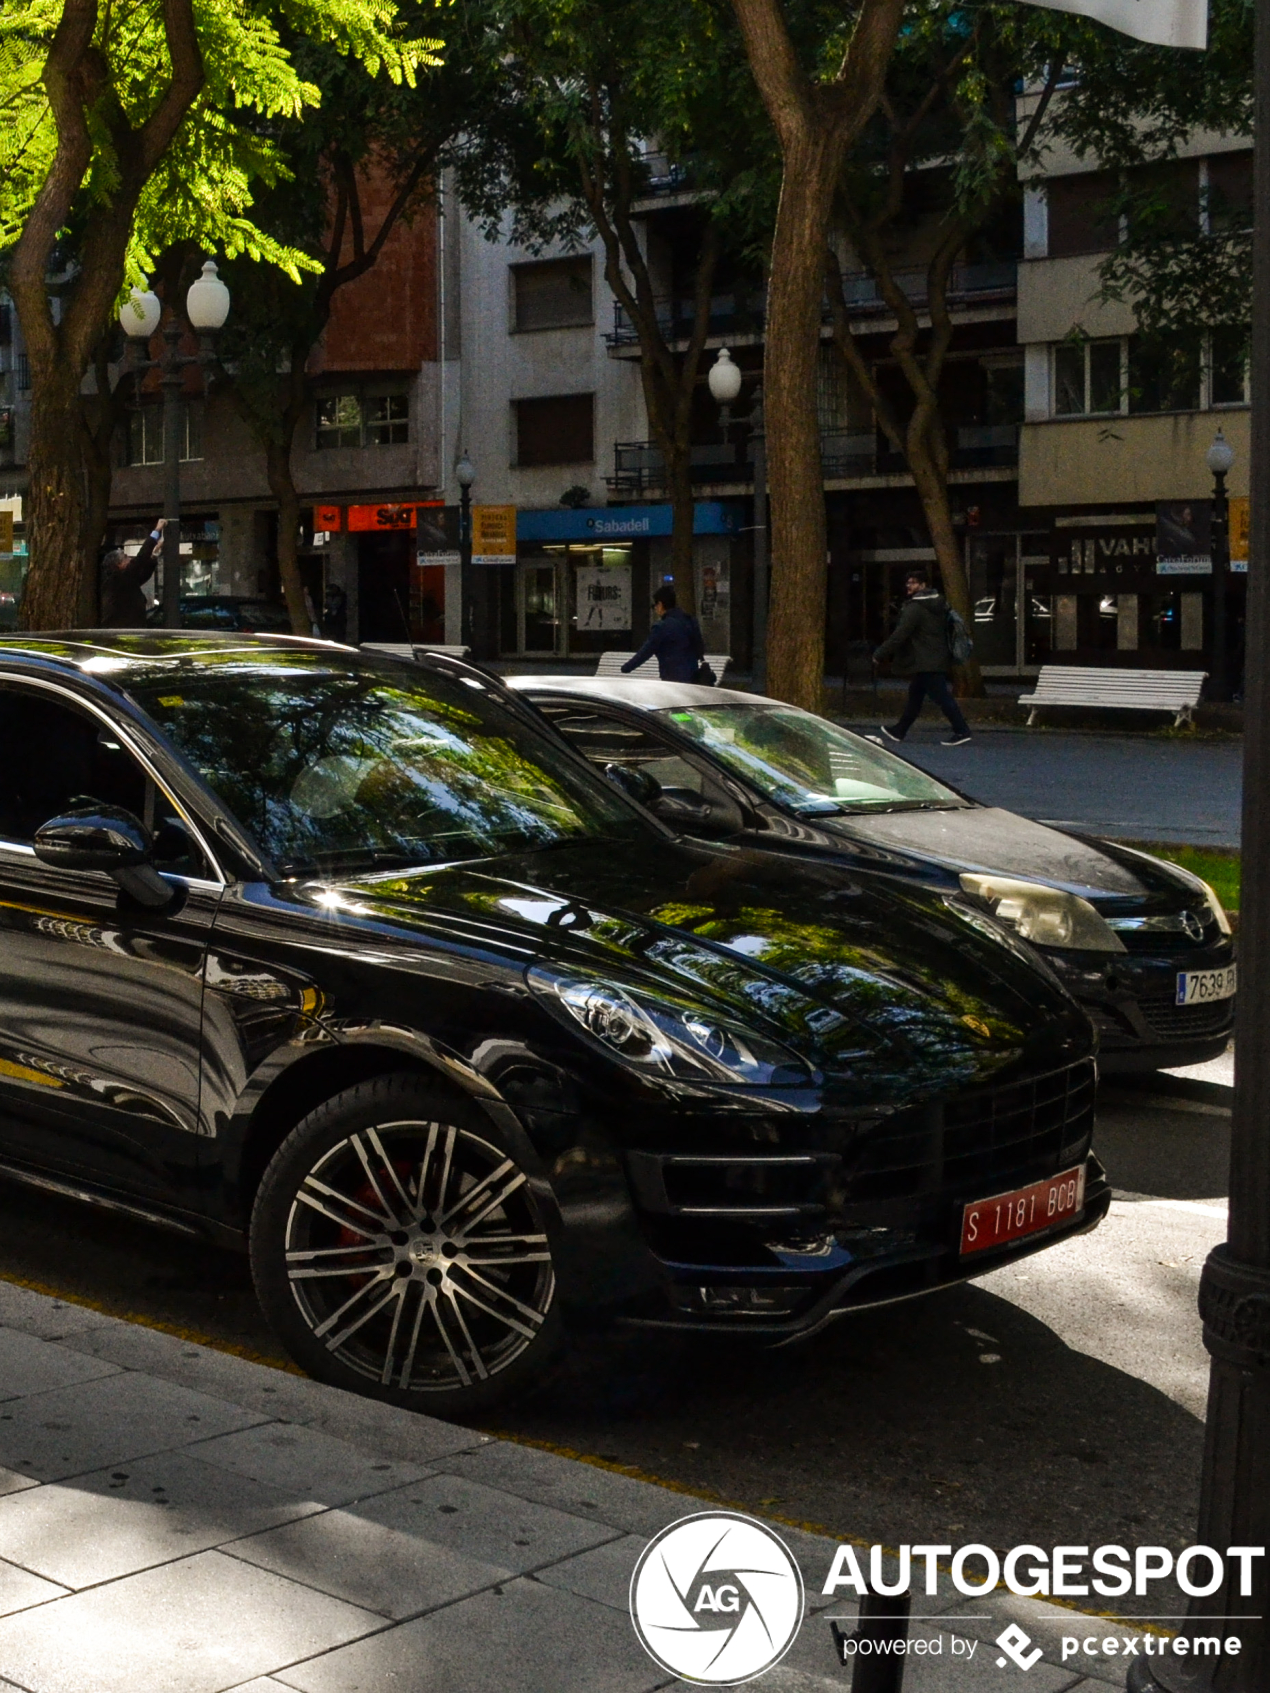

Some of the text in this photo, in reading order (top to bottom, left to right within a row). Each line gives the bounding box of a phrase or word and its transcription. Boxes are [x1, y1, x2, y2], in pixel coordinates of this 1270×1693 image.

[594, 517, 650, 533] Sabadell
[1156, 554, 1212, 563] CaixaForum
[1190, 972, 1224, 999] 7639
[967, 1211, 980, 1242] S
[994, 1194, 1036, 1235] 1181
[1047, 1179, 1077, 1217] BCB
